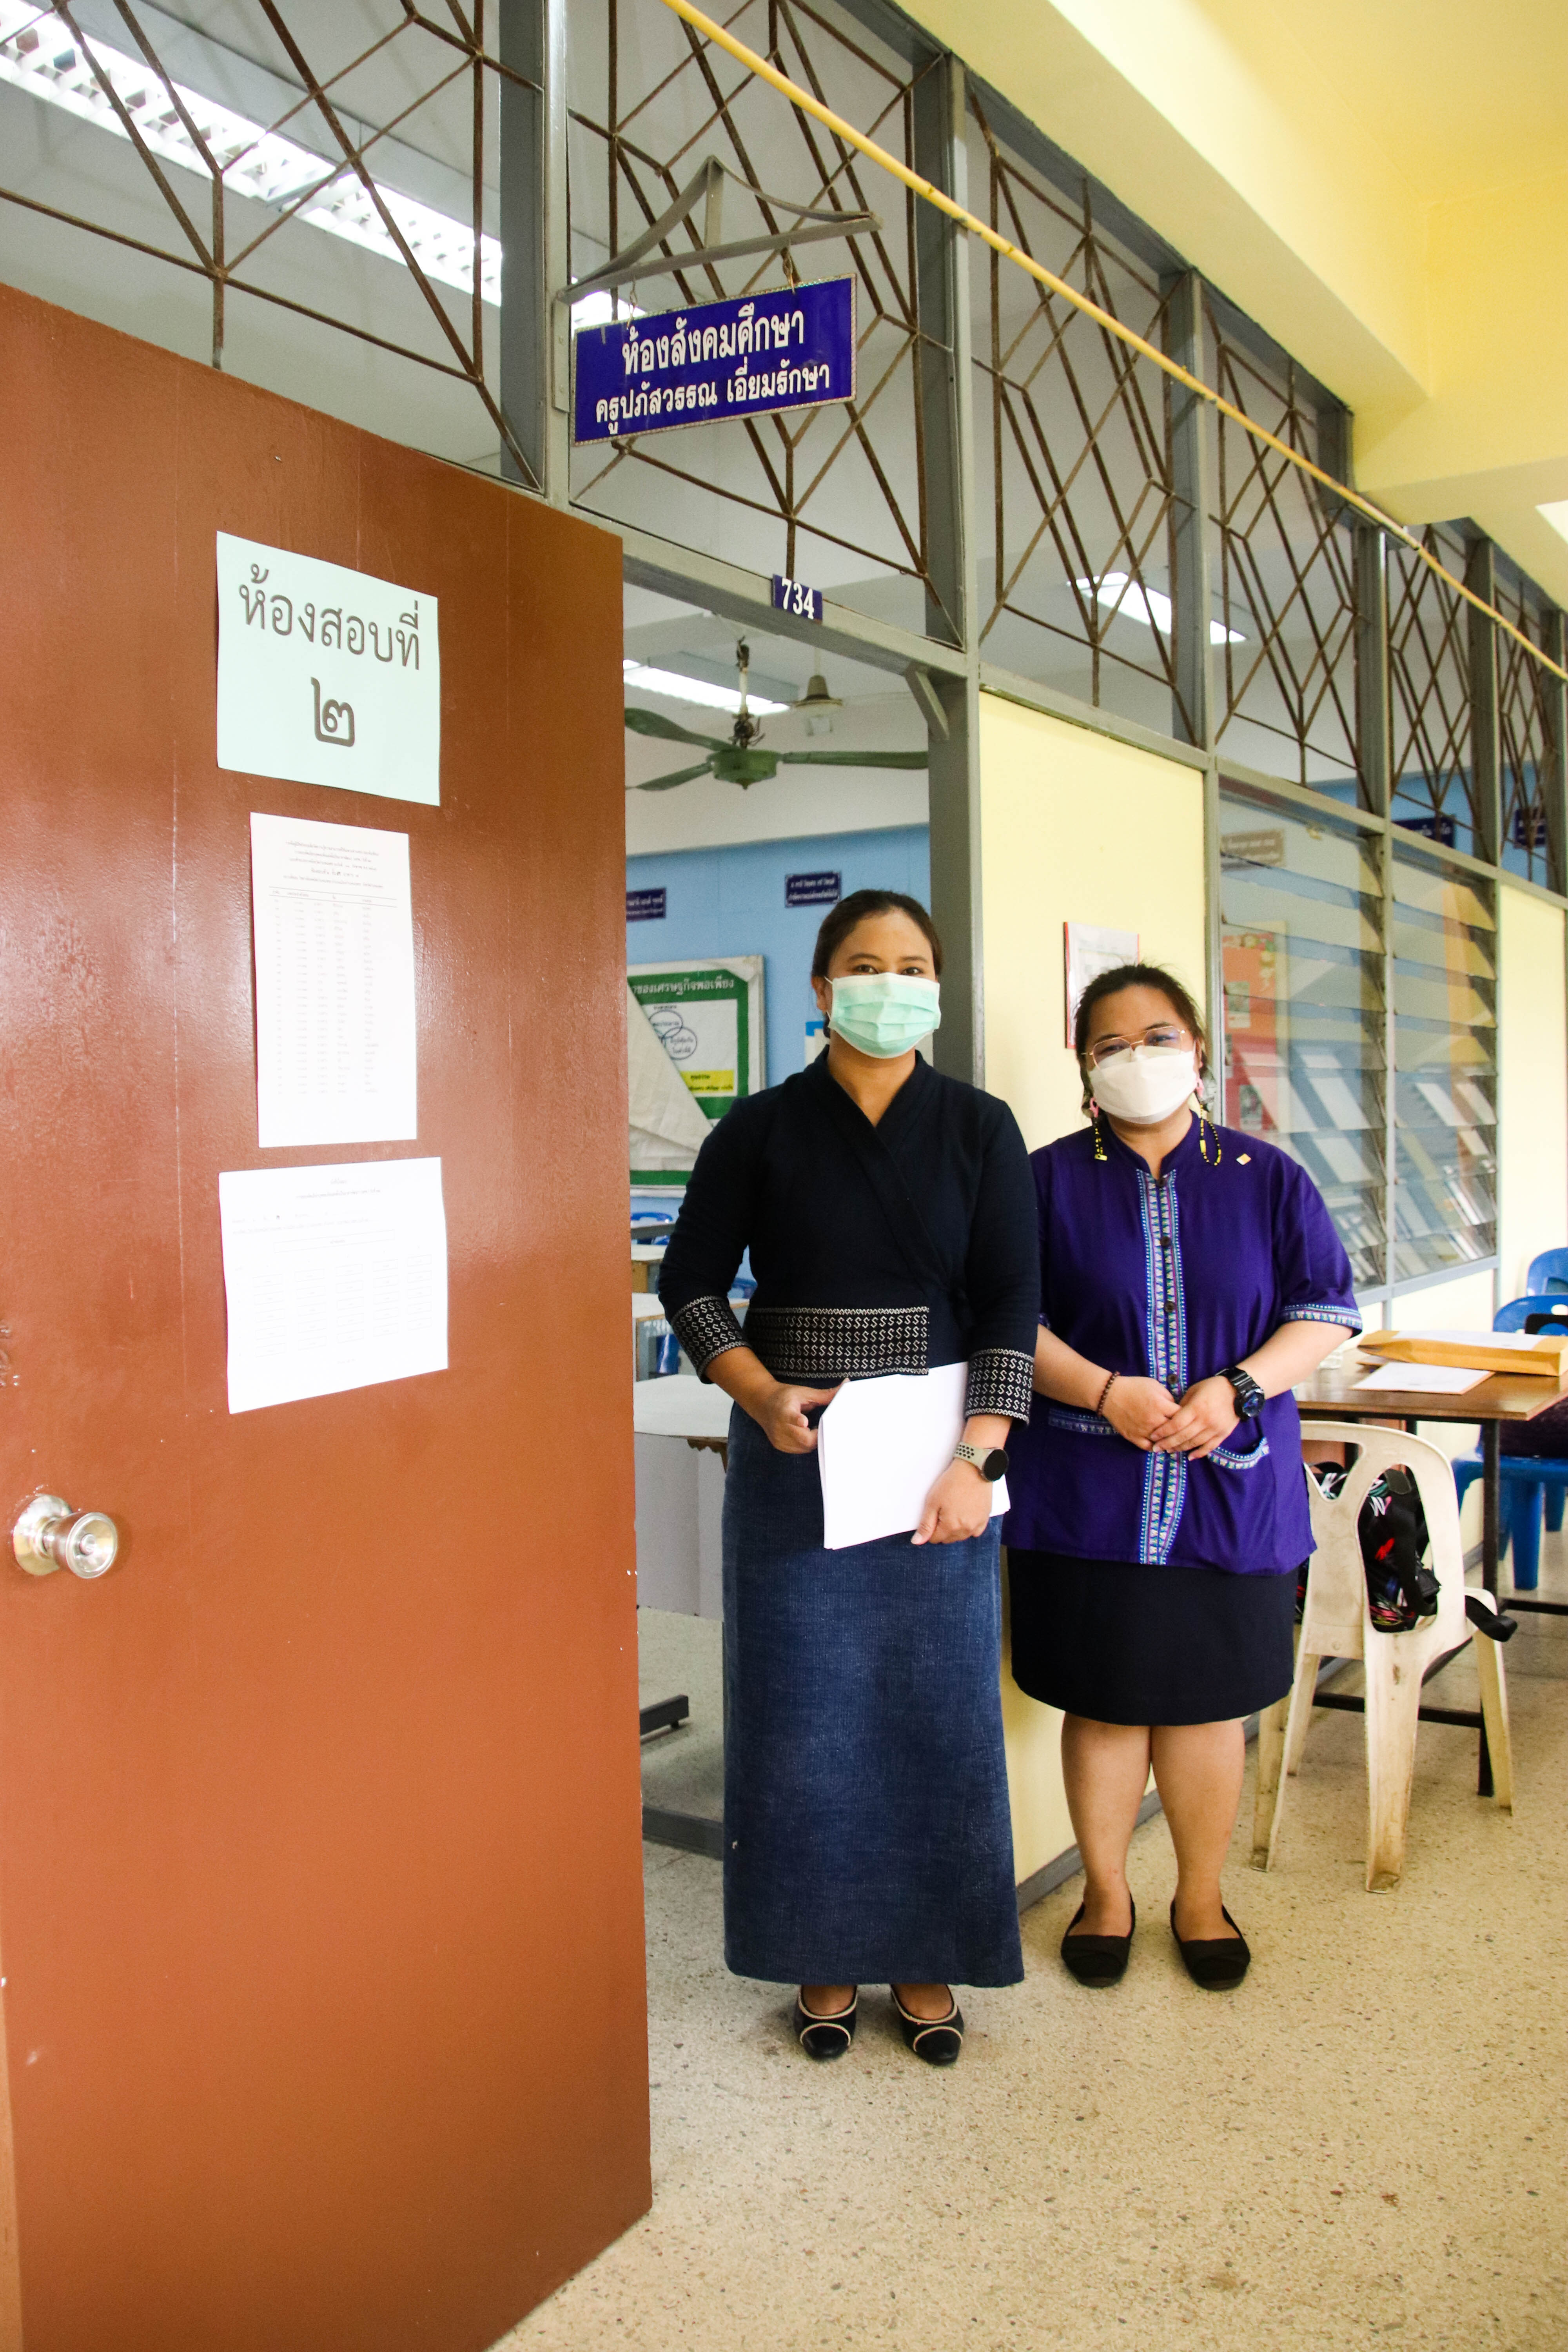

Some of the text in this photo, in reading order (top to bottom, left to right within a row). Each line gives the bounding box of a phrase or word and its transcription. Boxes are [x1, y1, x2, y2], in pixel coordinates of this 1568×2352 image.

[622, 302, 804, 375] ห้องสังคมศึกษา
[596, 356, 829, 434] ครูปภัสวรรณ เอี่ยมรักษา
[238, 563, 420, 670] ห้องสอบที่
[782, 577, 815, 619] 734
[310, 677, 355, 748] ๒
